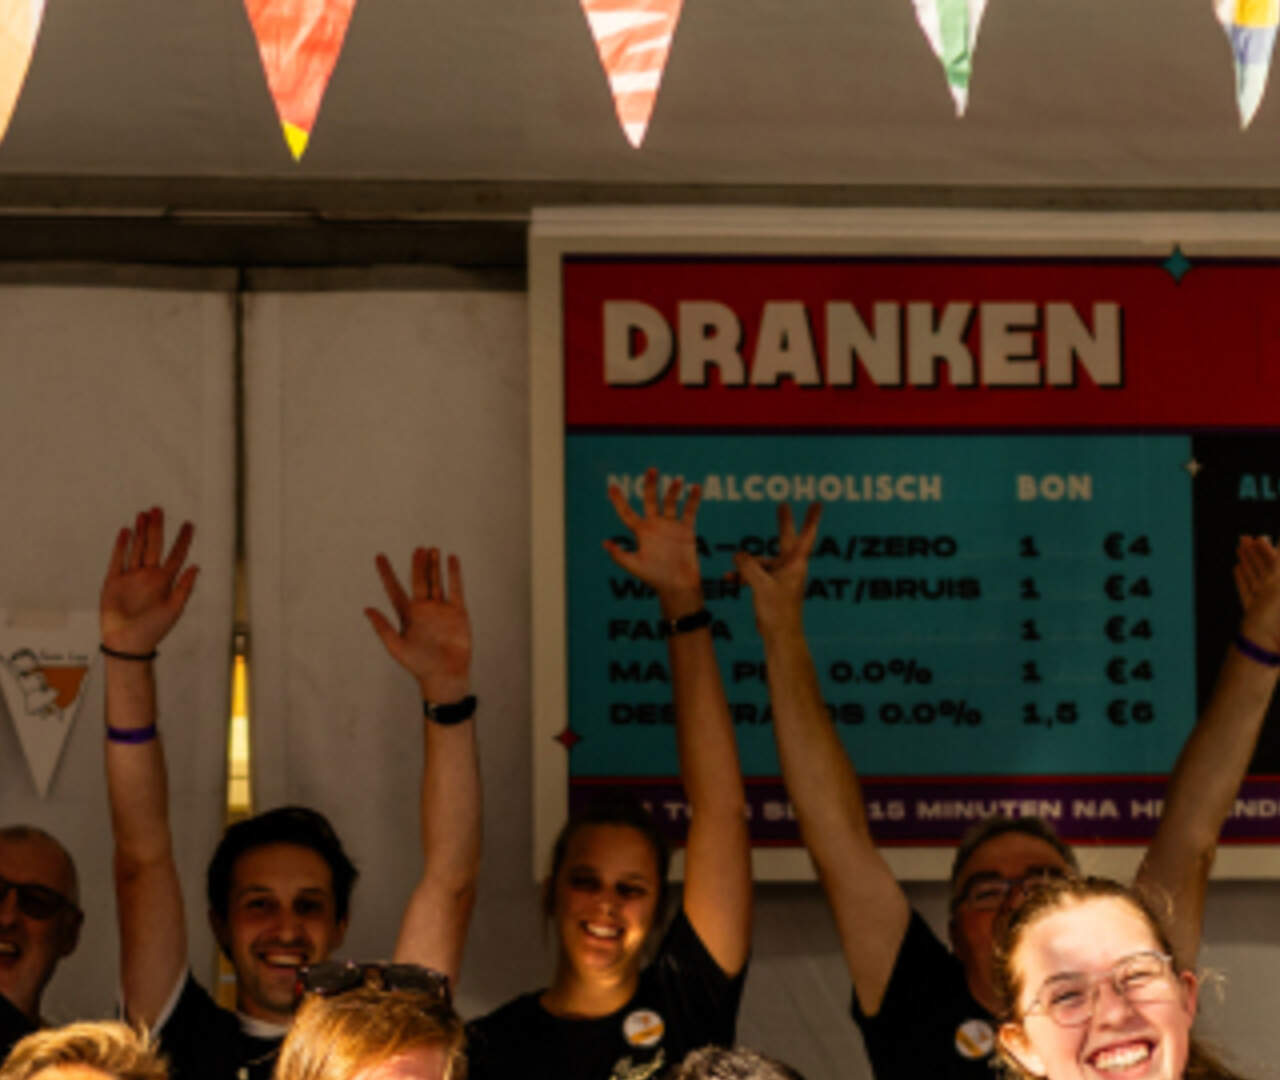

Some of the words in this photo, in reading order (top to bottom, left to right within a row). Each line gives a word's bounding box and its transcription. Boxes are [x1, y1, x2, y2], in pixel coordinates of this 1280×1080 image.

[602, 299, 1125, 390] DRANKEN
[1016, 474, 1092, 501] BON
[1019, 536, 1040, 558] 1
[1103, 532, 1152, 560] €4
[805, 578, 982, 603] AT/BRUIS
[1020, 579, 1040, 600] 1
[1103, 575, 1153, 603] €4
[1021, 620, 1041, 641] 1
[1103, 616, 1153, 644] €4
[830, 659, 932, 684] 0.0%
[1022, 662, 1042, 684] 1
[1105, 658, 1154, 686] €4
[880, 701, 982, 726] 0.0%
[1023, 704, 1079, 731] 1,5
[1106, 701, 1154, 728] €6
[916, 799, 1056, 820] MINUTEN
[1067, 798, 1115, 819] NA
